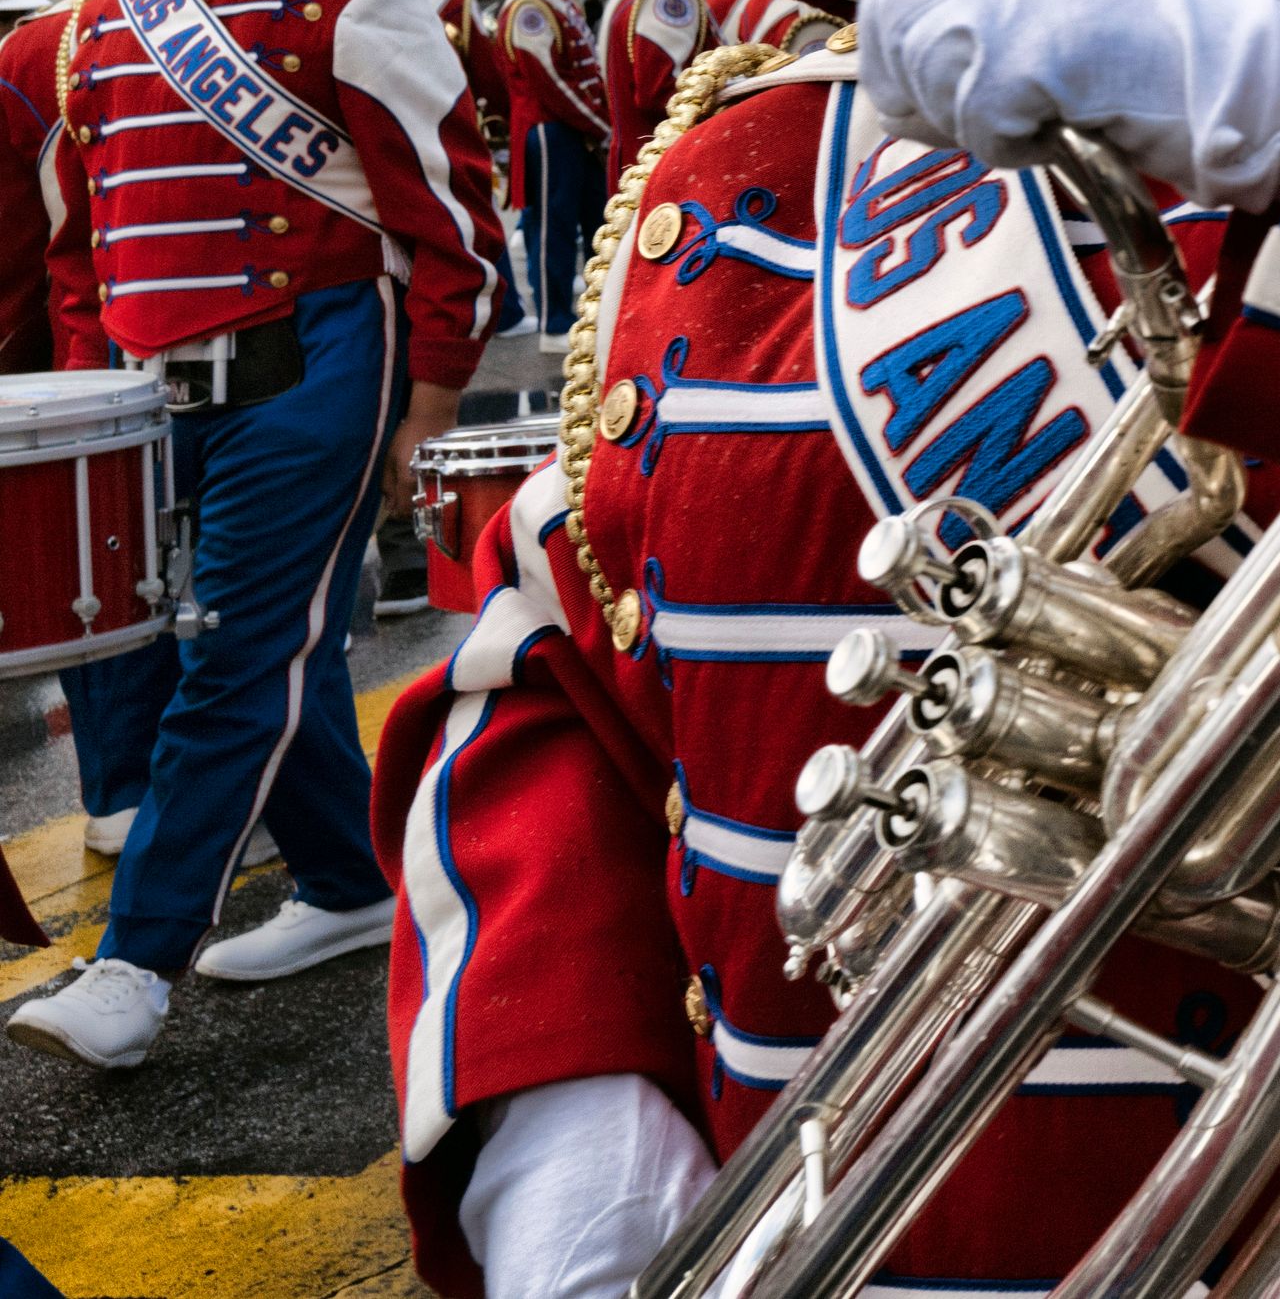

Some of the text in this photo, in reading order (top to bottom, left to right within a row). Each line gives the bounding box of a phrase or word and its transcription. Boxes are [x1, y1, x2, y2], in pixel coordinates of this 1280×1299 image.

[158, 23, 340, 178] ANGELES
[840, 137, 1093, 554] OS AN
